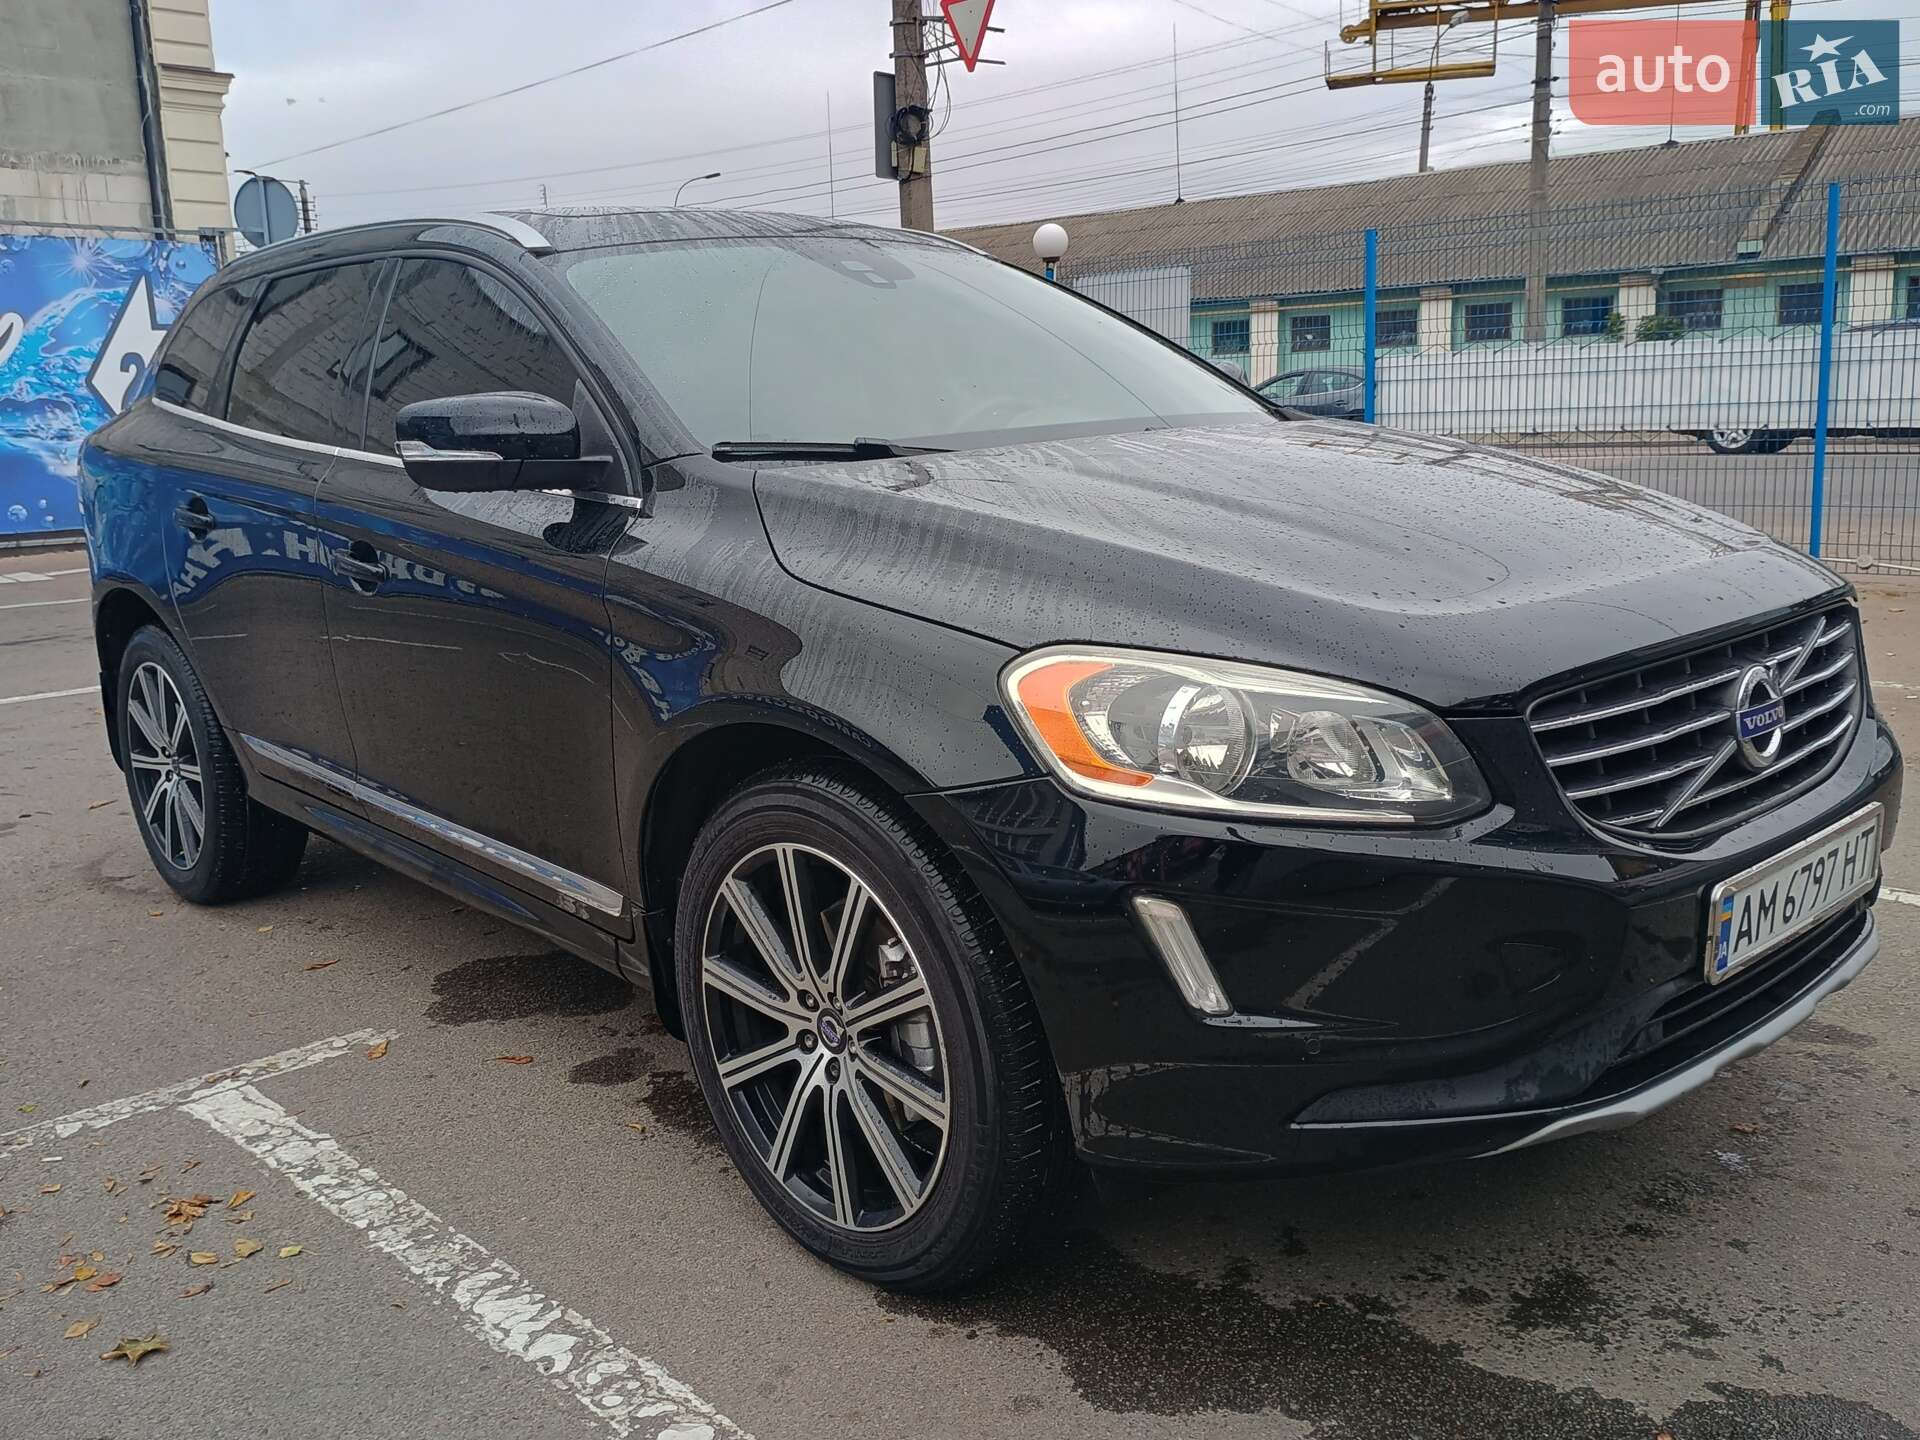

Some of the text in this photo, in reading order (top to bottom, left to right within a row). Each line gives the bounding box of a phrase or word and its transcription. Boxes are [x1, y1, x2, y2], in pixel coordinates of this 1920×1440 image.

[1744, 706, 1785, 730] VOLVO
[1733, 881, 1779, 953] AM
[1782, 848, 1840, 924] 6797
